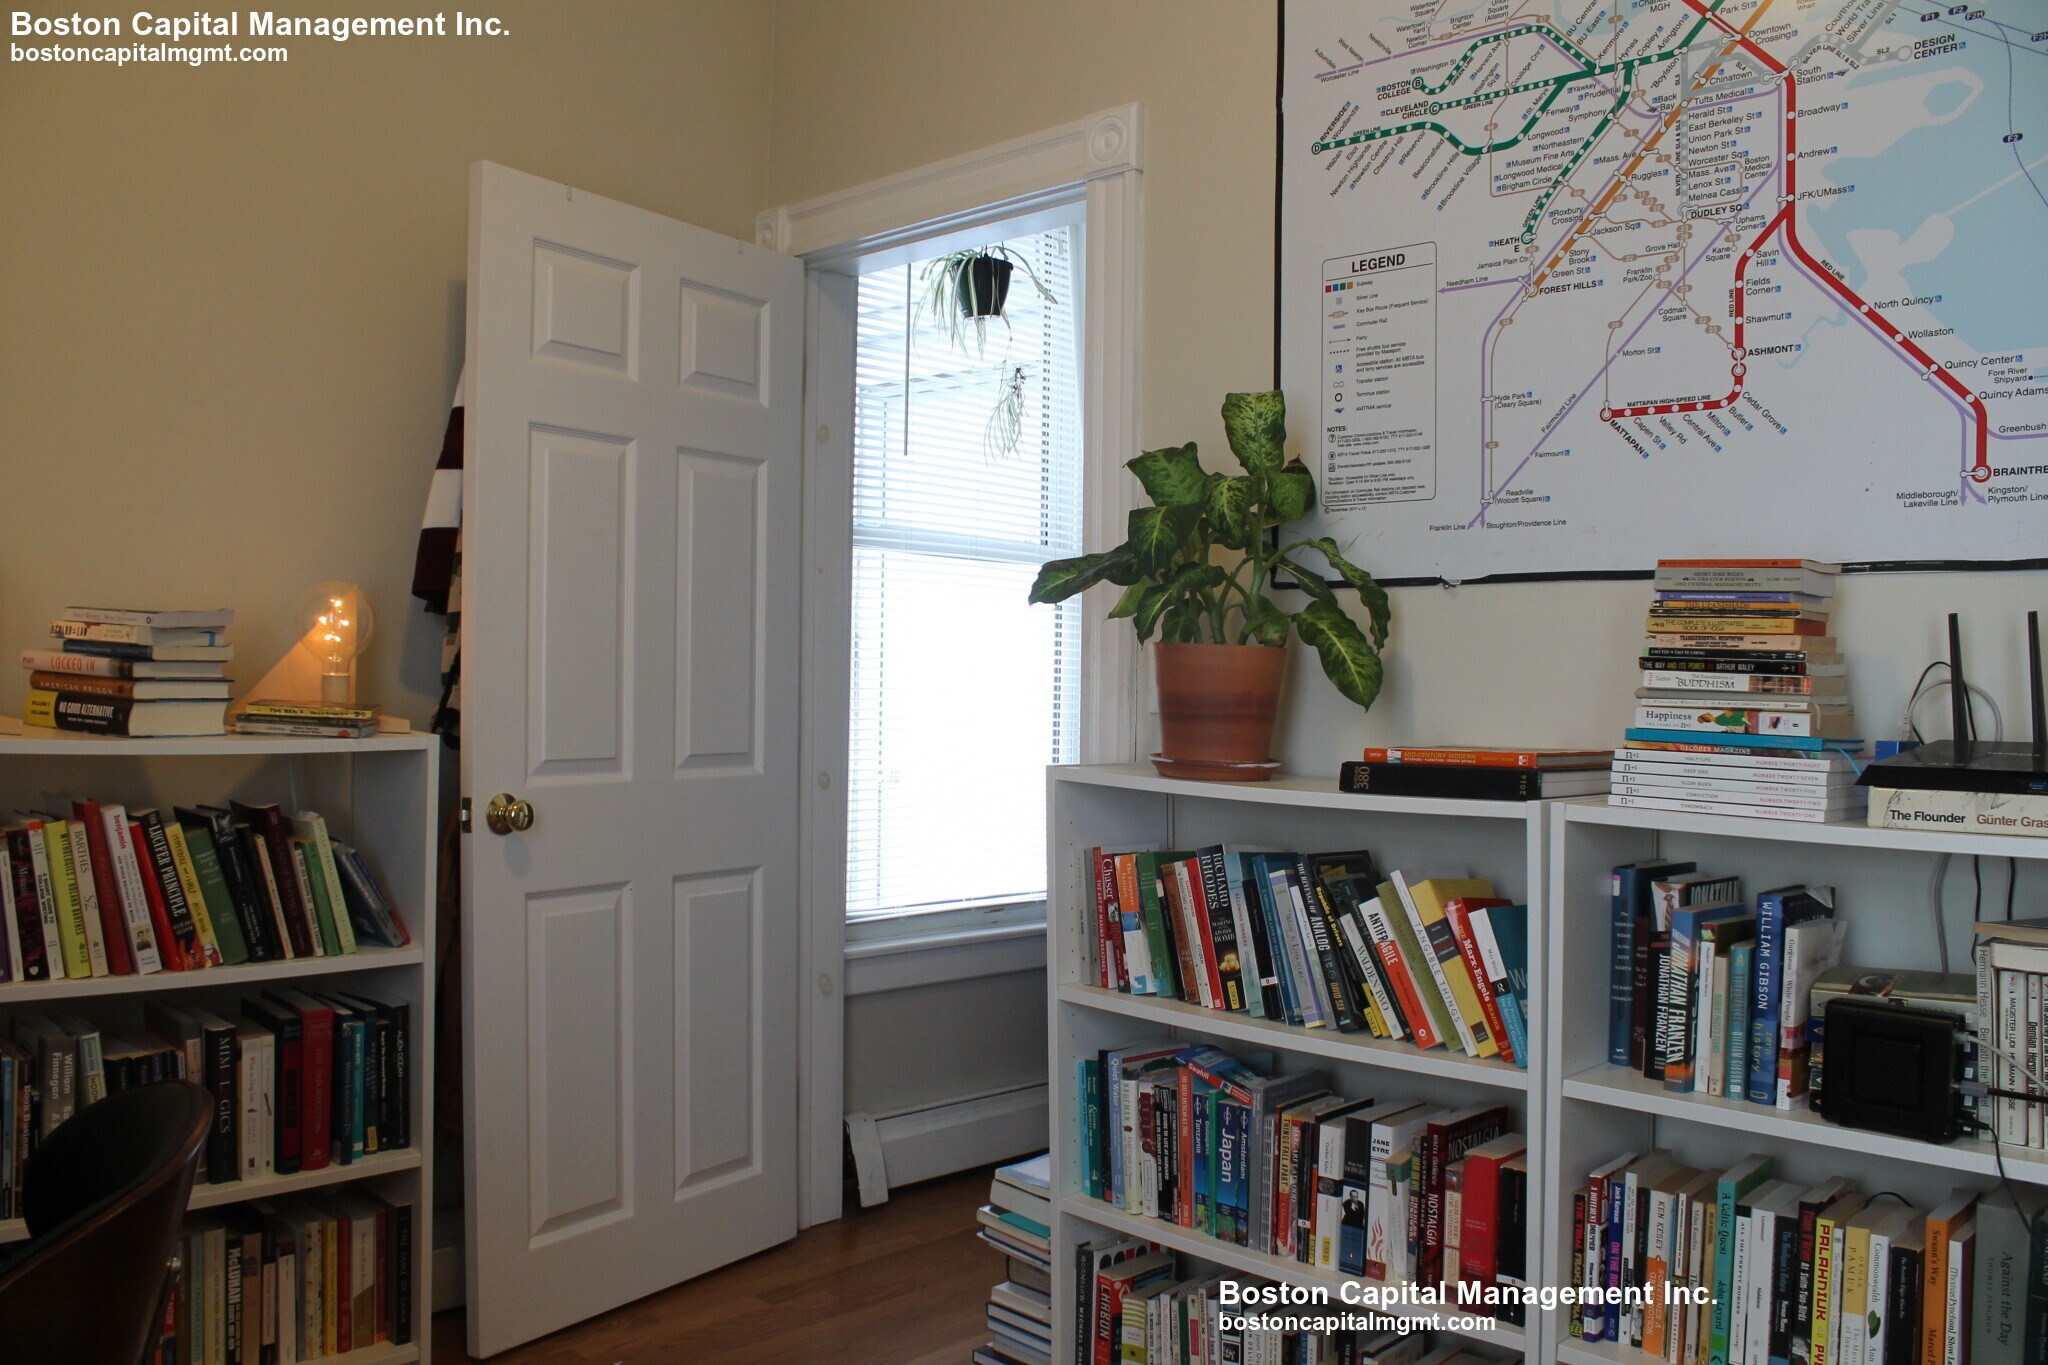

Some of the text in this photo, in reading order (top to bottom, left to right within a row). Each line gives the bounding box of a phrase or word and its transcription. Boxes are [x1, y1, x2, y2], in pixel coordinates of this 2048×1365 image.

[1720, 2, 1750, 15] Park St
[1658, 20, 1685, 51] Arlington
[1749, 23, 1791, 39] Downtown
[1755, 32, 1791, 46] Crossing
[1598, 26, 1624, 59] Kenmore
[1914, 34, 1955, 50] DESIGN
[1914, 43, 1958, 60] CENTER
[1709, 70, 1752, 86] Chinatown
[1796, 66, 1822, 77] South
[1796, 73, 1827, 85] Station
[1377, 87, 1411, 101] COLLEGE
[1381, 80, 1411, 93] BOSTON
[1694, 88, 1748, 106] Tufts Medical
[1385, 101, 1429, 116] CLEVELAND
[1402, 107, 1429, 120] CIRCLE
[1545, 105, 1574, 117] Fenway
[1568, 109, 1607, 122] Symphony
[1797, 103, 1841, 118] Broadway
[1688, 111, 1755, 132] East Berkeley St
[1527, 128, 1564, 141] Longwood
[1688, 125, 1744, 143] Union Park St
[1538, 136, 1585, 152] Northeastern
[1688, 140, 1730, 155] Newton St
[1688, 151, 1743, 166] Worcester Sq
[1797, 146, 1831, 159] Andrew
[1631, 170, 1662, 181] Ruggles
[1688, 186, 1740, 202] Melnea Cass
[1797, 186, 1847, 201] JFK/UMass
[1690, 204, 1743, 219] DUDLEY SQ
[1756, 248, 1779, 259] Savin
[1351, 253, 1406, 273] LEGEND
[1756, 259, 1769, 267] Hill
[1539, 280, 1598, 295] FOREST HILLS
[1746, 277, 1771, 287] Fields
[1745, 285, 1775, 296] Corner
[1874, 294, 1935, 311] North Quincy
[1745, 312, 1785, 325] Shawmut
[1908, 327, 1954, 340] Wollaston
[1747, 344, 1794, 357] ASHMONT
[1944, 354, 2014, 370] Quincy Center
[1978, 386, 2048, 401] Quincy Adams
[1742, 391, 1782, 431] Cedar Grove
[1998, 423, 2047, 434] Greenbush
[1609, 419, 1645, 455] MATTAPAN
[50, 656, 96, 672] LOCKED IN
[1643, 661, 1653, 669] THE
[1654, 661, 1665, 670] WAY
[1667, 661, 1677, 670] AND
[1688, 662, 1705, 670] POWER
[1716, 662, 1736, 671] ARTHUR
[1738, 663, 1755, 671] WALEY
[1677, 677, 1736, 689] BUDDHISM
[58, 701, 113, 718] NO GOOD ALTERNATIVE
[1646, 710, 1692, 721] Happiness
[1404, 750, 1477, 760] MID-CENTURY MODERN
[1680, 744, 1752, 755] DECODER MAGAZINE
[1357, 766, 1370, 790] 380
[1778, 774, 1819, 782] TWENTY-SEVEN
[1779, 810, 1816, 819] TWENTY-ONE
[1890, 809, 1911, 821] The
[1914, 811, 1966, 823] Flounder
[1976, 814, 2017, 826] Günter
[114, 814, 127, 850] benjamin
[74, 830, 90, 874] BARTHES
[148, 823, 187, 918] LUCIFER PRINCIPLE
[1102, 858, 1114, 899] Chaser
[1201, 855, 1220, 910] RHODES
[1212, 853, 1229, 908] RICHARD
[1309, 915, 1331, 952] ANALOG
[1367, 911, 1399, 966] ANTIFRAGILE
[1757, 901, 1773, 1010] WILLIAM GIBSON
[1357, 945, 1390, 1012] WALDEN TWO
[1413, 922, 1460, 1023] TANGIBLE THINGS
[1978, 949, 1989, 1018] Hermann Hesse
[1655, 952, 1670, 1052] JONATHAN FRANZEN
[1751, 1023, 1765, 1073] history
[1764, 1031, 1773, 1055] zero
[49, 1052, 62, 1100] Finnegan
[63, 1053, 73, 1095] William
[1188, 1062, 1210, 1080] Swahili
[1372, 1138, 1390, 1147] JANE
[1372, 1146, 1390, 1155] EYRE
[1218, 1128, 1236, 1183] Japan
[1240, 1132, 1249, 1180] Amsterdam
[1280, 1119, 1291, 1187] THINGS FALL APART
[1426, 1193, 1439, 1247] NOSTALGIA
[1721, 1202, 1731, 1228] Celtic
[1655, 1200, 1666, 1252] KEN KESEY
[1719, 1229, 1730, 1256] Quest
[1928, 1229, 1941, 1287] Swann's Way
[1815, 1223, 1831, 1321] PALAHNIUK
[1871, 1242, 1884, 1303] Commonwealth
[1998, 1252, 2014, 1346] Against the Day
[1100, 1286, 1112, 1340] CHABON
